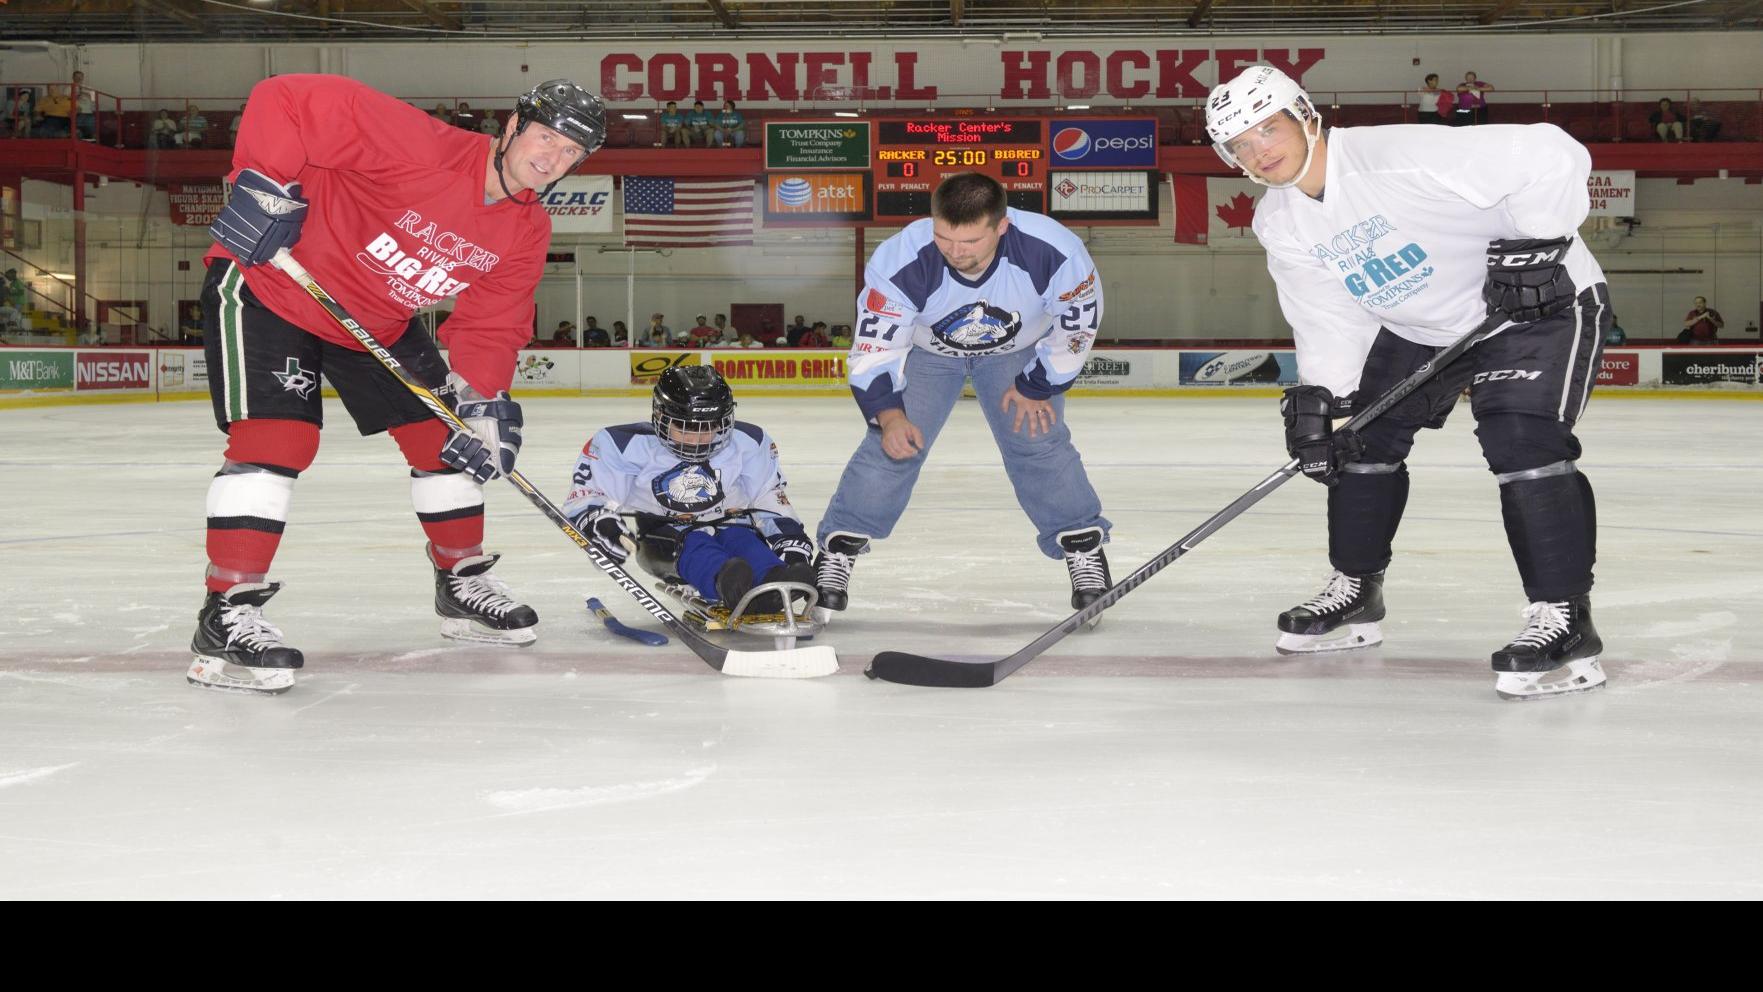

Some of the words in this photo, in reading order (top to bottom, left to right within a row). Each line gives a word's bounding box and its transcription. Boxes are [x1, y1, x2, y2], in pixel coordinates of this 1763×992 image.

[600, 53, 938, 101] CORNELL
[1000, 50, 1325, 99] HOCKEY
[1211, 90, 1231, 109] 23
[1218, 109, 1242, 126] CCM
[779, 129, 843, 141] TOMPKINS
[907, 122, 952, 132] Racker
[959, 122, 1011, 132] Center's
[810, 140, 843, 148] Company
[937, 133, 981, 142] Mission
[1095, 134, 1153, 152] pepsi
[879, 151, 926, 159] RACKER
[934, 151, 986, 165] 25:00
[903, 162, 914, 177] 0
[1018, 161, 1028, 176] 0
[182, 184, 223, 193] NATIONAL
[1587, 177, 1611, 186] CAA
[170, 195, 199, 203] FIGURE
[202, 195, 224, 203] SKAT
[817, 185, 855, 198] at&t
[394, 210, 500, 273] RACKER
[1309, 215, 1397, 261] ACKER
[365, 232, 423, 280] BIG
[416, 246, 456, 271] RIVALS
[1362, 242, 1428, 288] RED
[1487, 248, 1560, 267] CCM
[1364, 274, 1424, 308] TOMPKINS
[1384, 300, 1399, 310] Trust
[1399, 282, 1429, 303] Company
[1061, 300, 1098, 331] 27
[341, 318, 401, 370] BAUER
[10, 360, 36, 380] M&T
[36, 360, 60, 380] Bank
[78, 362, 149, 382] NISSAN
[715, 360, 797, 378] BOATYARD
[801, 359, 845, 378] GRILL
[1084, 361, 1127, 371] STREET
[1601, 360, 1631, 369] tore
[1473, 369, 1543, 385] CCM
[431, 384, 457, 397] BAU
[1303, 461, 1327, 469] CCM
[562, 525, 589, 548] MX3
[588, 547, 673, 624] SUPREME
